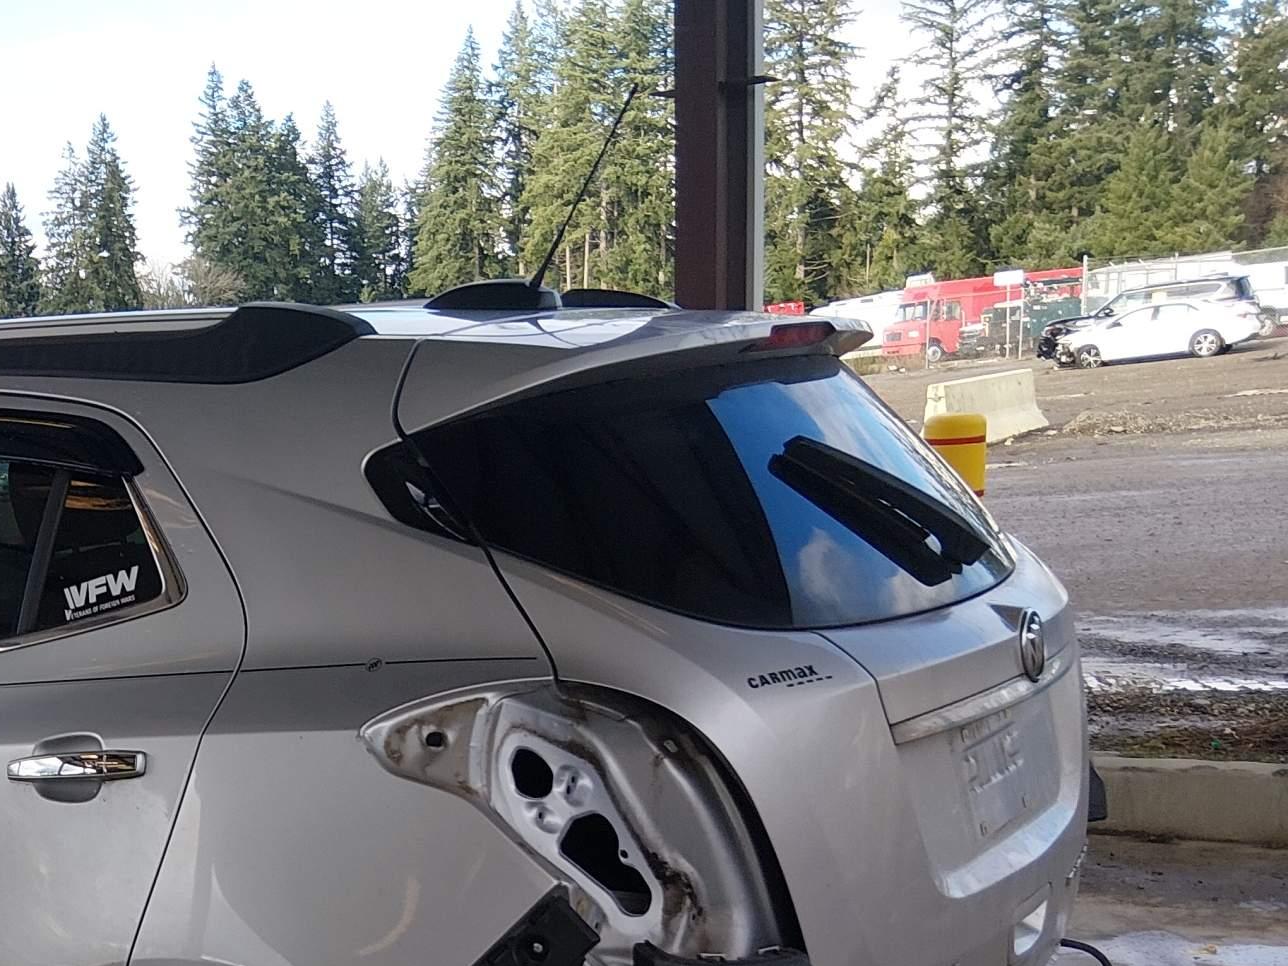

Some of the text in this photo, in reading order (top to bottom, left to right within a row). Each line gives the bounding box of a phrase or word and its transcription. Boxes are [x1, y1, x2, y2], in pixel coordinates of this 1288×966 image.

[64, 565, 139, 609] VFW
[65, 607, 92, 621] VETERANS
[100, 600, 120, 611] FOREIGN
